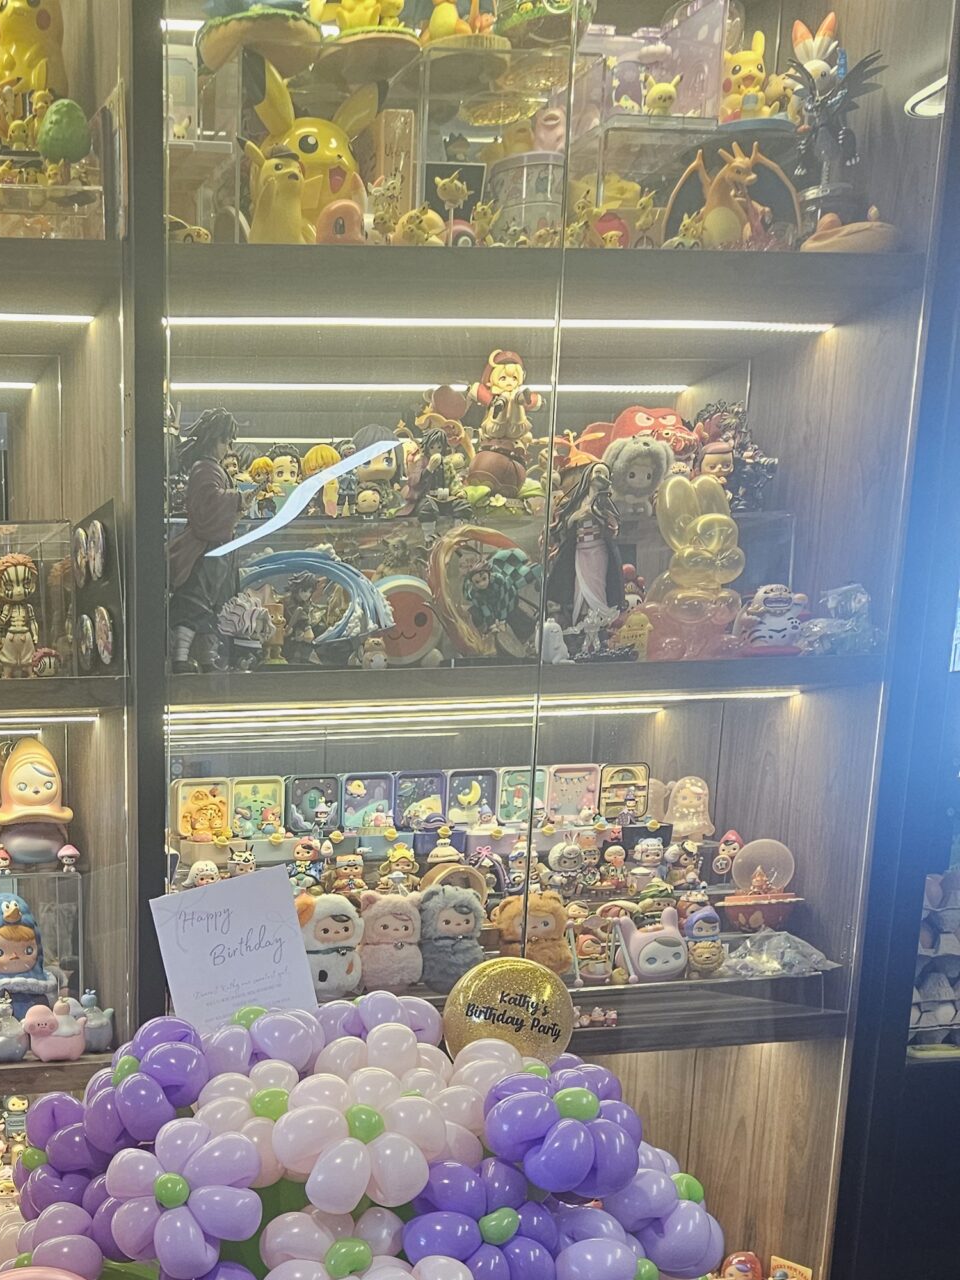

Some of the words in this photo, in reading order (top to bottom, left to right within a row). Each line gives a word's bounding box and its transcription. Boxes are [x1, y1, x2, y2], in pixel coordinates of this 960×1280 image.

[178, 906, 233, 935] Happy
[209, 924, 286, 966] Birthday
[499, 990, 550, 1017] Kathy's
[465, 1002, 526, 1033] Birthday
[530, 1017, 562, 1043] Party
